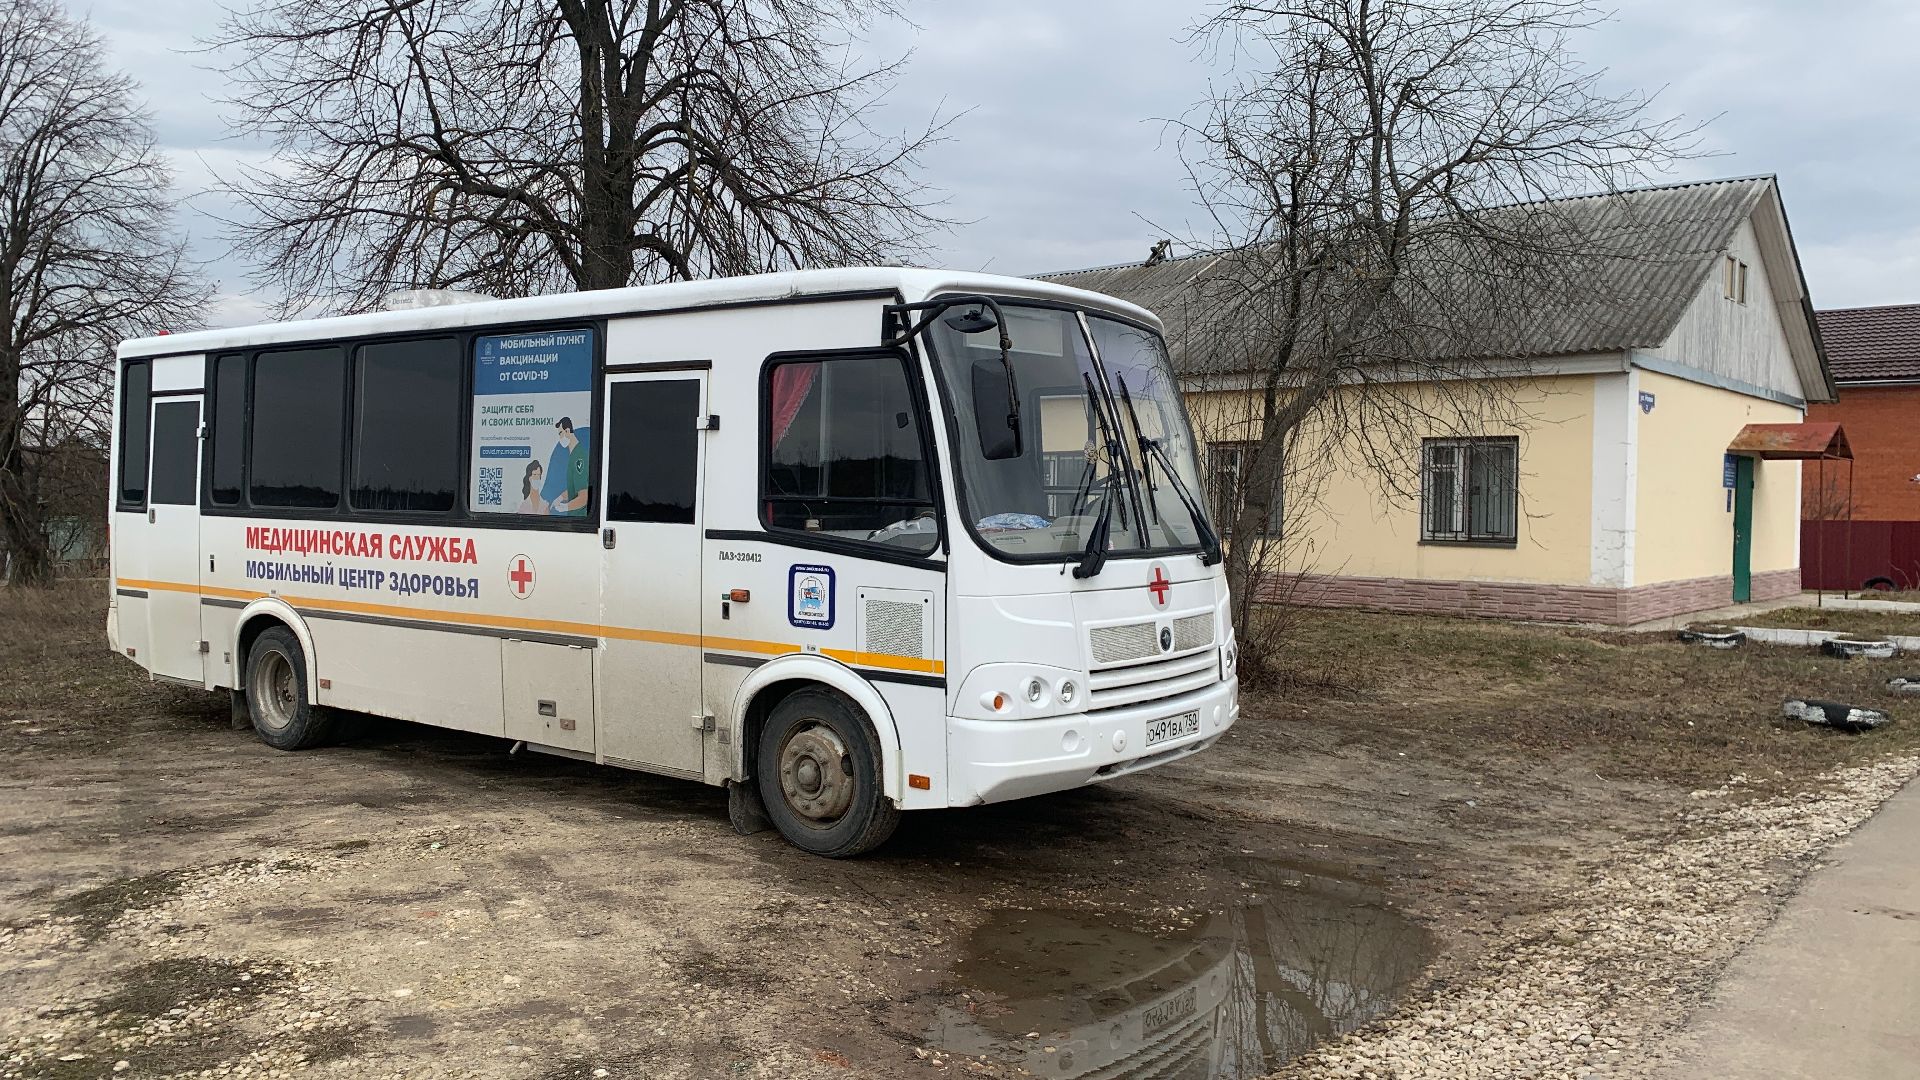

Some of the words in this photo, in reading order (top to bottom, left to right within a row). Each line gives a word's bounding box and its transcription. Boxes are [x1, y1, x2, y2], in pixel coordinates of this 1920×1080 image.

[500, 335, 555, 350] МОБИЛЬНЫЙ
[556, 335, 586, 346] ПУНКТ
[499, 353, 558, 366] ВАКЦИНАЦИИ
[499, 372, 510, 381] ОТ
[511, 371, 549, 380] COVID-19
[481, 405, 513, 415] ЗАЩИТИ
[515, 404, 534, 414] СЕБЯ
[481, 419, 487, 427] И
[488, 418, 513, 427] СВОИХ
[515, 417, 554, 426] БЛИЗКИХ!
[246, 526, 382, 558] МЕДИЦИНСКАЯ
[389, 534, 478, 564] СЛУЖБА
[246, 560, 333, 585] МОБИЛЬНЫЙ
[339, 568, 385, 590] ЦЕНТР
[389, 571, 479, 599] ЗДОРОВЬЯ
[1184, 713, 1197, 727] 750
